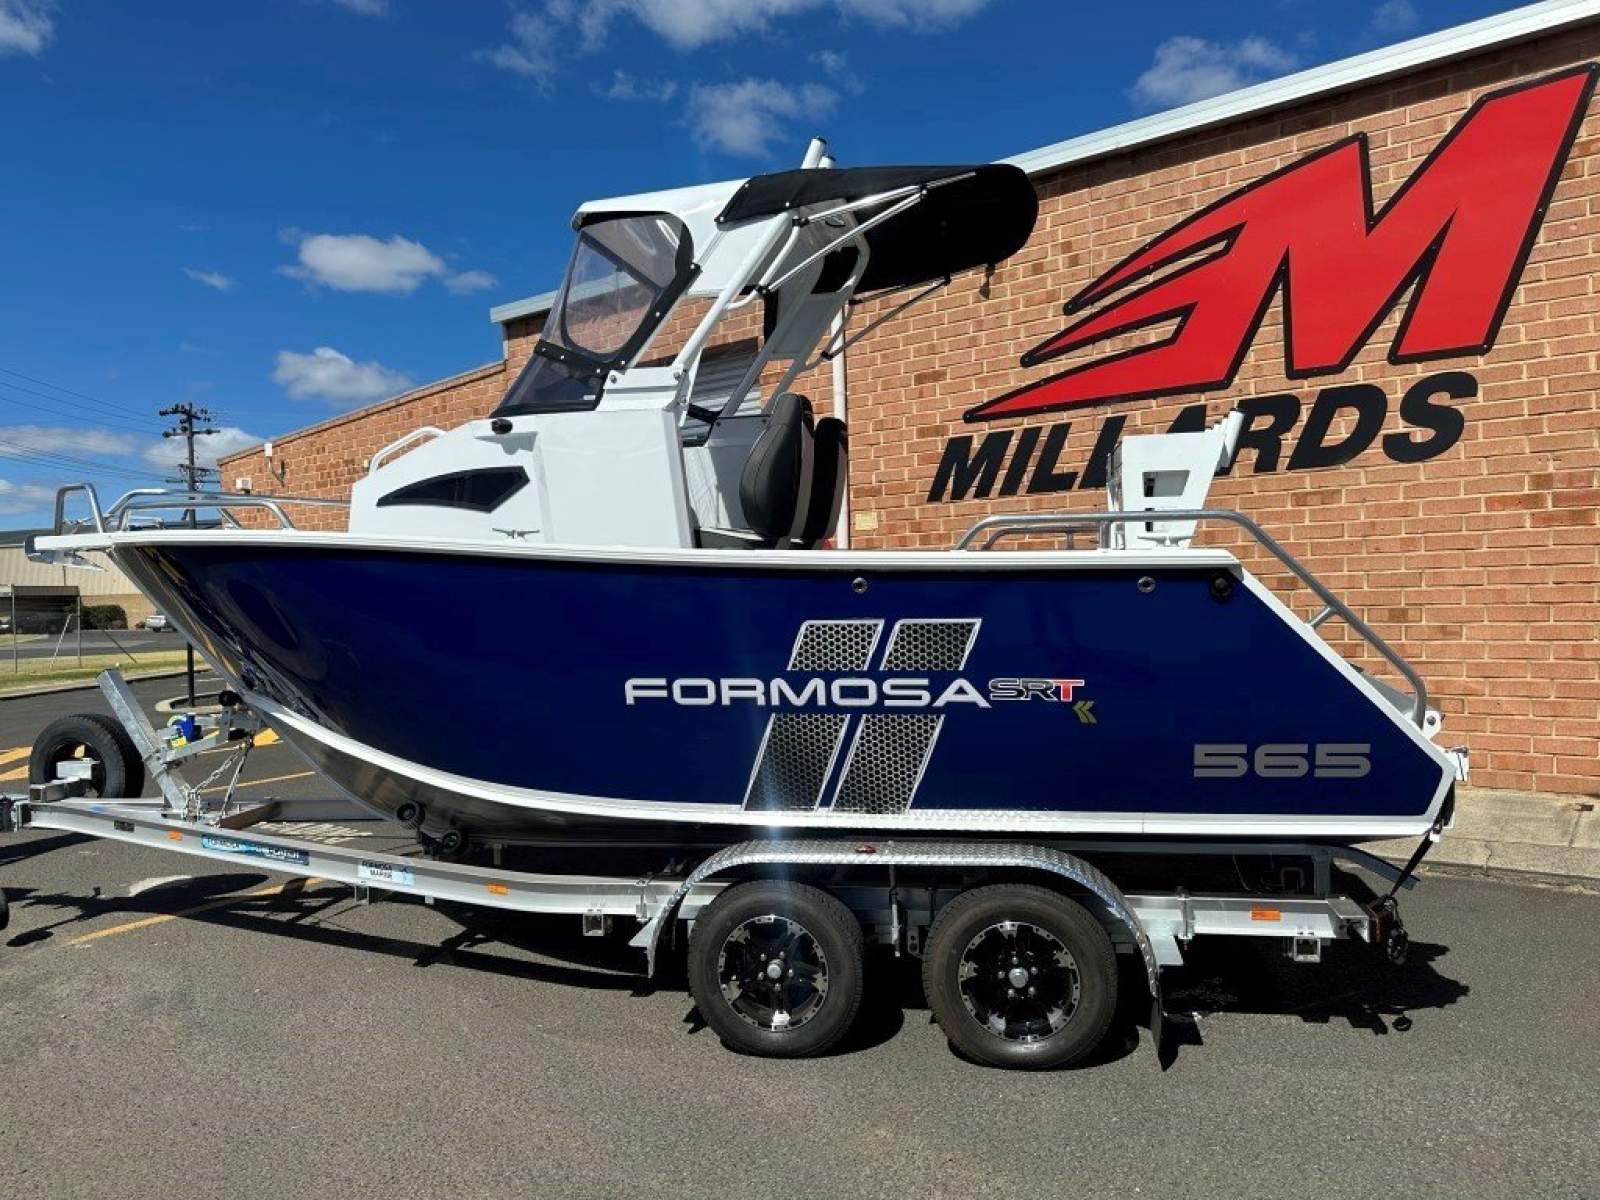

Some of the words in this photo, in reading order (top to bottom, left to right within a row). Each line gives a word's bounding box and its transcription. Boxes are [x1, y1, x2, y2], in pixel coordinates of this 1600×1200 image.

[624, 677, 992, 708] FORMOSA
[988, 677, 1085, 702] SRT
[1193, 743, 1372, 778] 565
